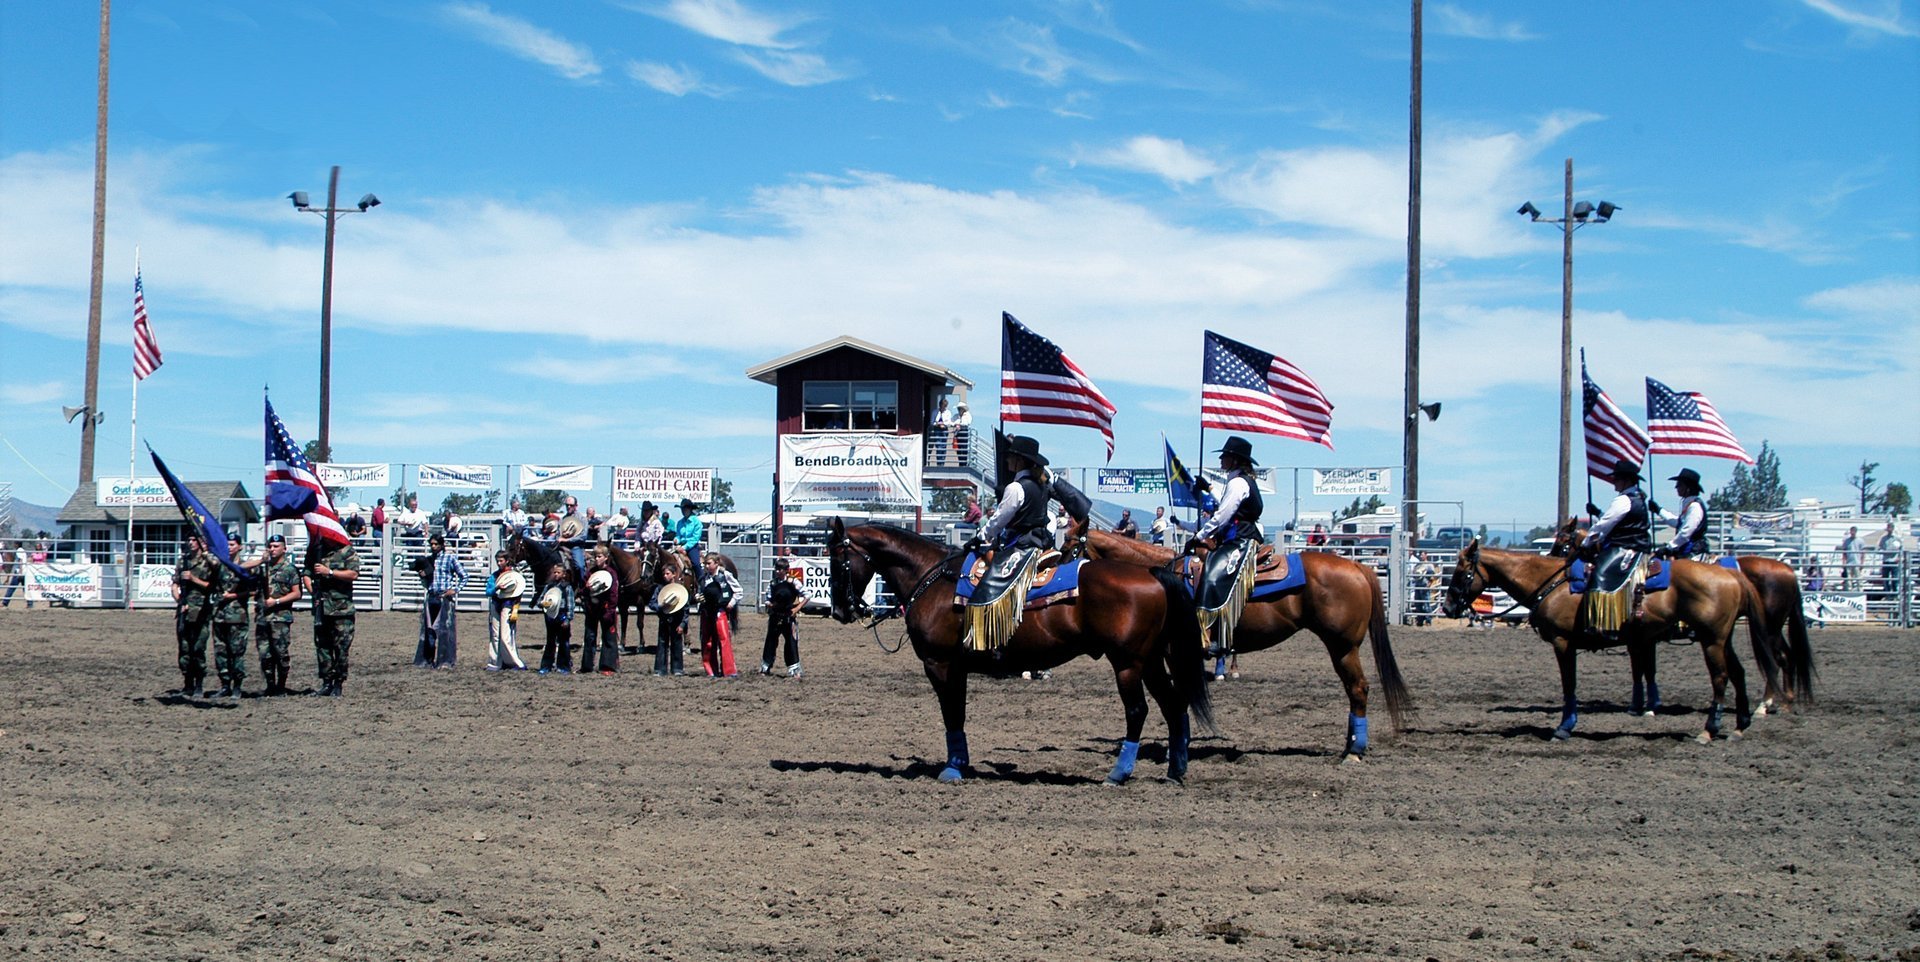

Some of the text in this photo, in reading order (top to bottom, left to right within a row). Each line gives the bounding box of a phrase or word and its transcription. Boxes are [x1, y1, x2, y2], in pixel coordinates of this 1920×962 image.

[795, 456, 908, 467] BendBroadband
[617, 469, 709, 479] REDMOND IMMEDIATE
[1322, 470, 1364, 478] STERLING
[617, 480, 708, 491] HEALTH CARE
[631, 491, 650, 499] Doctor
[395, 555, 403, 566] 2
[806, 567, 830, 577] COL
[806, 578, 832, 587] RIV
[1820, 594, 1846, 604] PUMP
